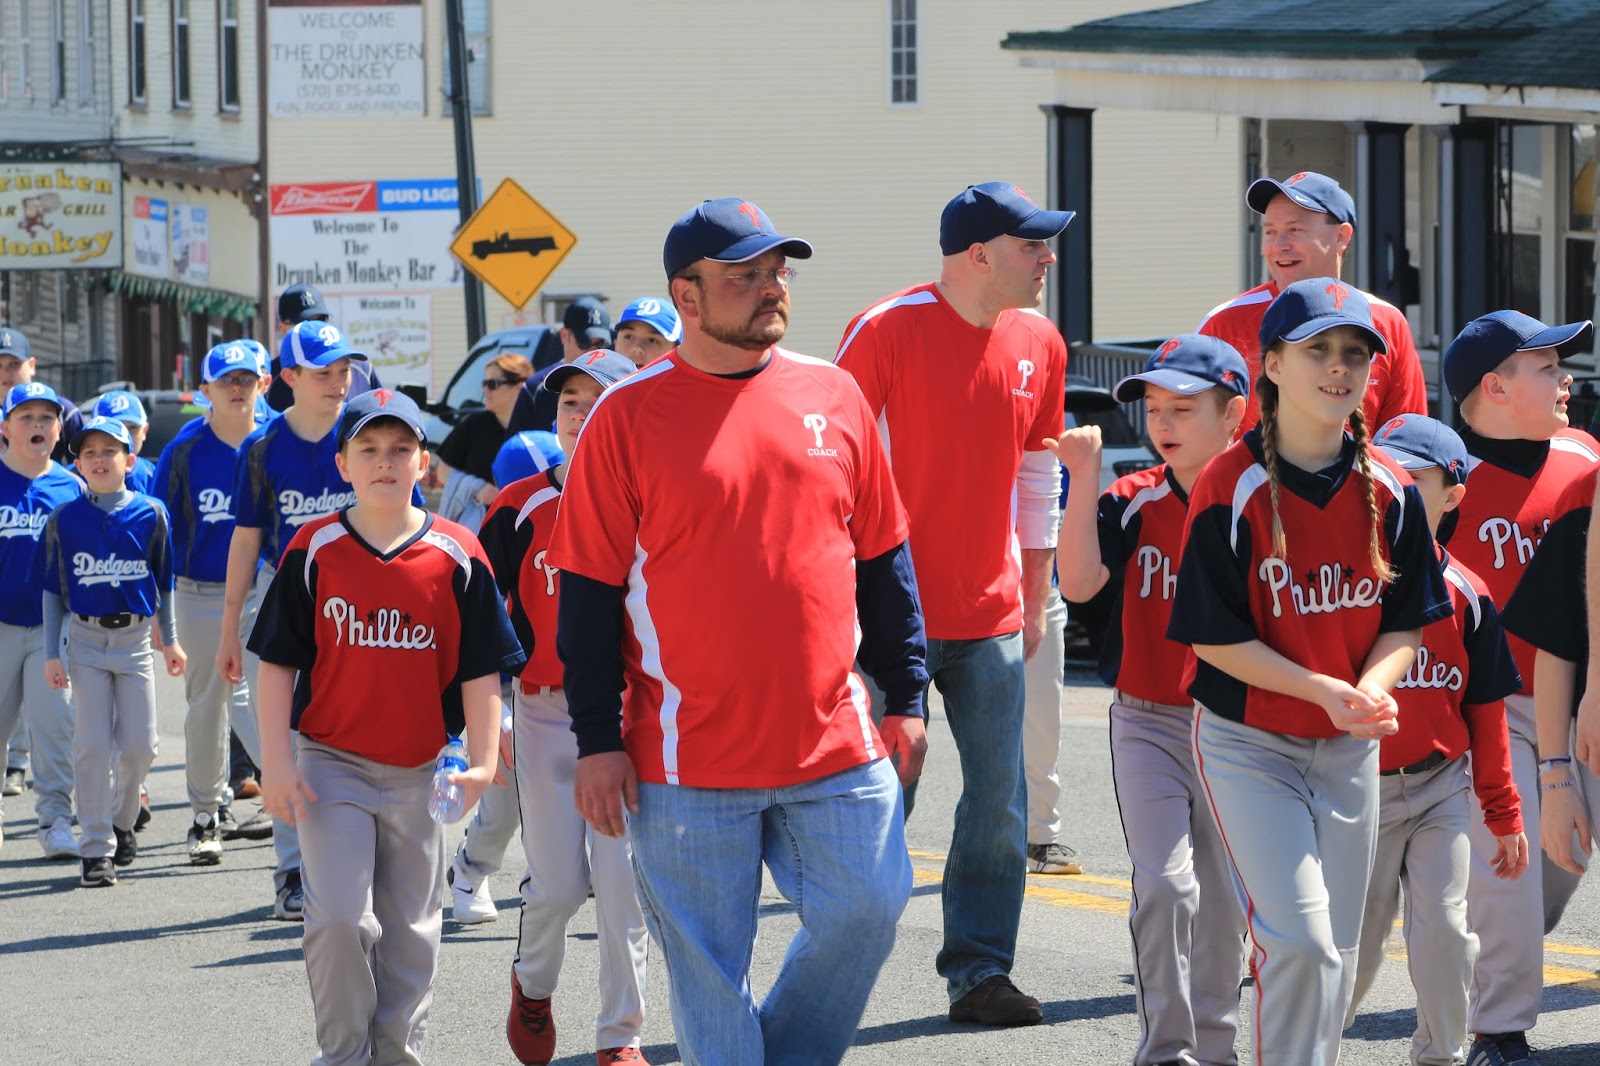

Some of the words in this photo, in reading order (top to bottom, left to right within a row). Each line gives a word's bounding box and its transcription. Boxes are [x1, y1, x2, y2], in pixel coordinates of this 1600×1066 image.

[300, 11, 395, 29] WELCOME
[340, 30, 357, 41] TO
[272, 44, 312, 61] THE
[319, 42, 423, 61] DRUNKEN
[301, 62, 396, 80] MONKEY
[0, 168, 112, 195] runken
[382, 188, 421, 204] BUD
[422, 185, 459, 203] LIG
[63, 203, 107, 217] GRILL
[313, 219, 376, 235] Welcome
[382, 216, 399, 233] To
[342, 239, 370, 255] The
[277, 261, 342, 287] Drunken
[346, 259, 402, 288] Monkey
[408, 257, 436, 282] Bar
[1325, 283, 1350, 310] P
[636, 299, 661, 317] D
[317, 325, 340, 347] D
[224, 346, 245, 365] D
[587, 351, 608, 366] P
[1157, 338, 1180, 363] P
[1016, 359, 1035, 389] P
[25, 381, 46, 397] D
[373, 389, 394, 408] P
[1012, 387, 1034, 399] COACH
[803, 413, 828, 448] P
[1381, 417, 1406, 439] P
[807, 447, 838, 457] COACH
[0, 505, 49, 542] Dodg
[73, 552, 149, 588] Dodgers
